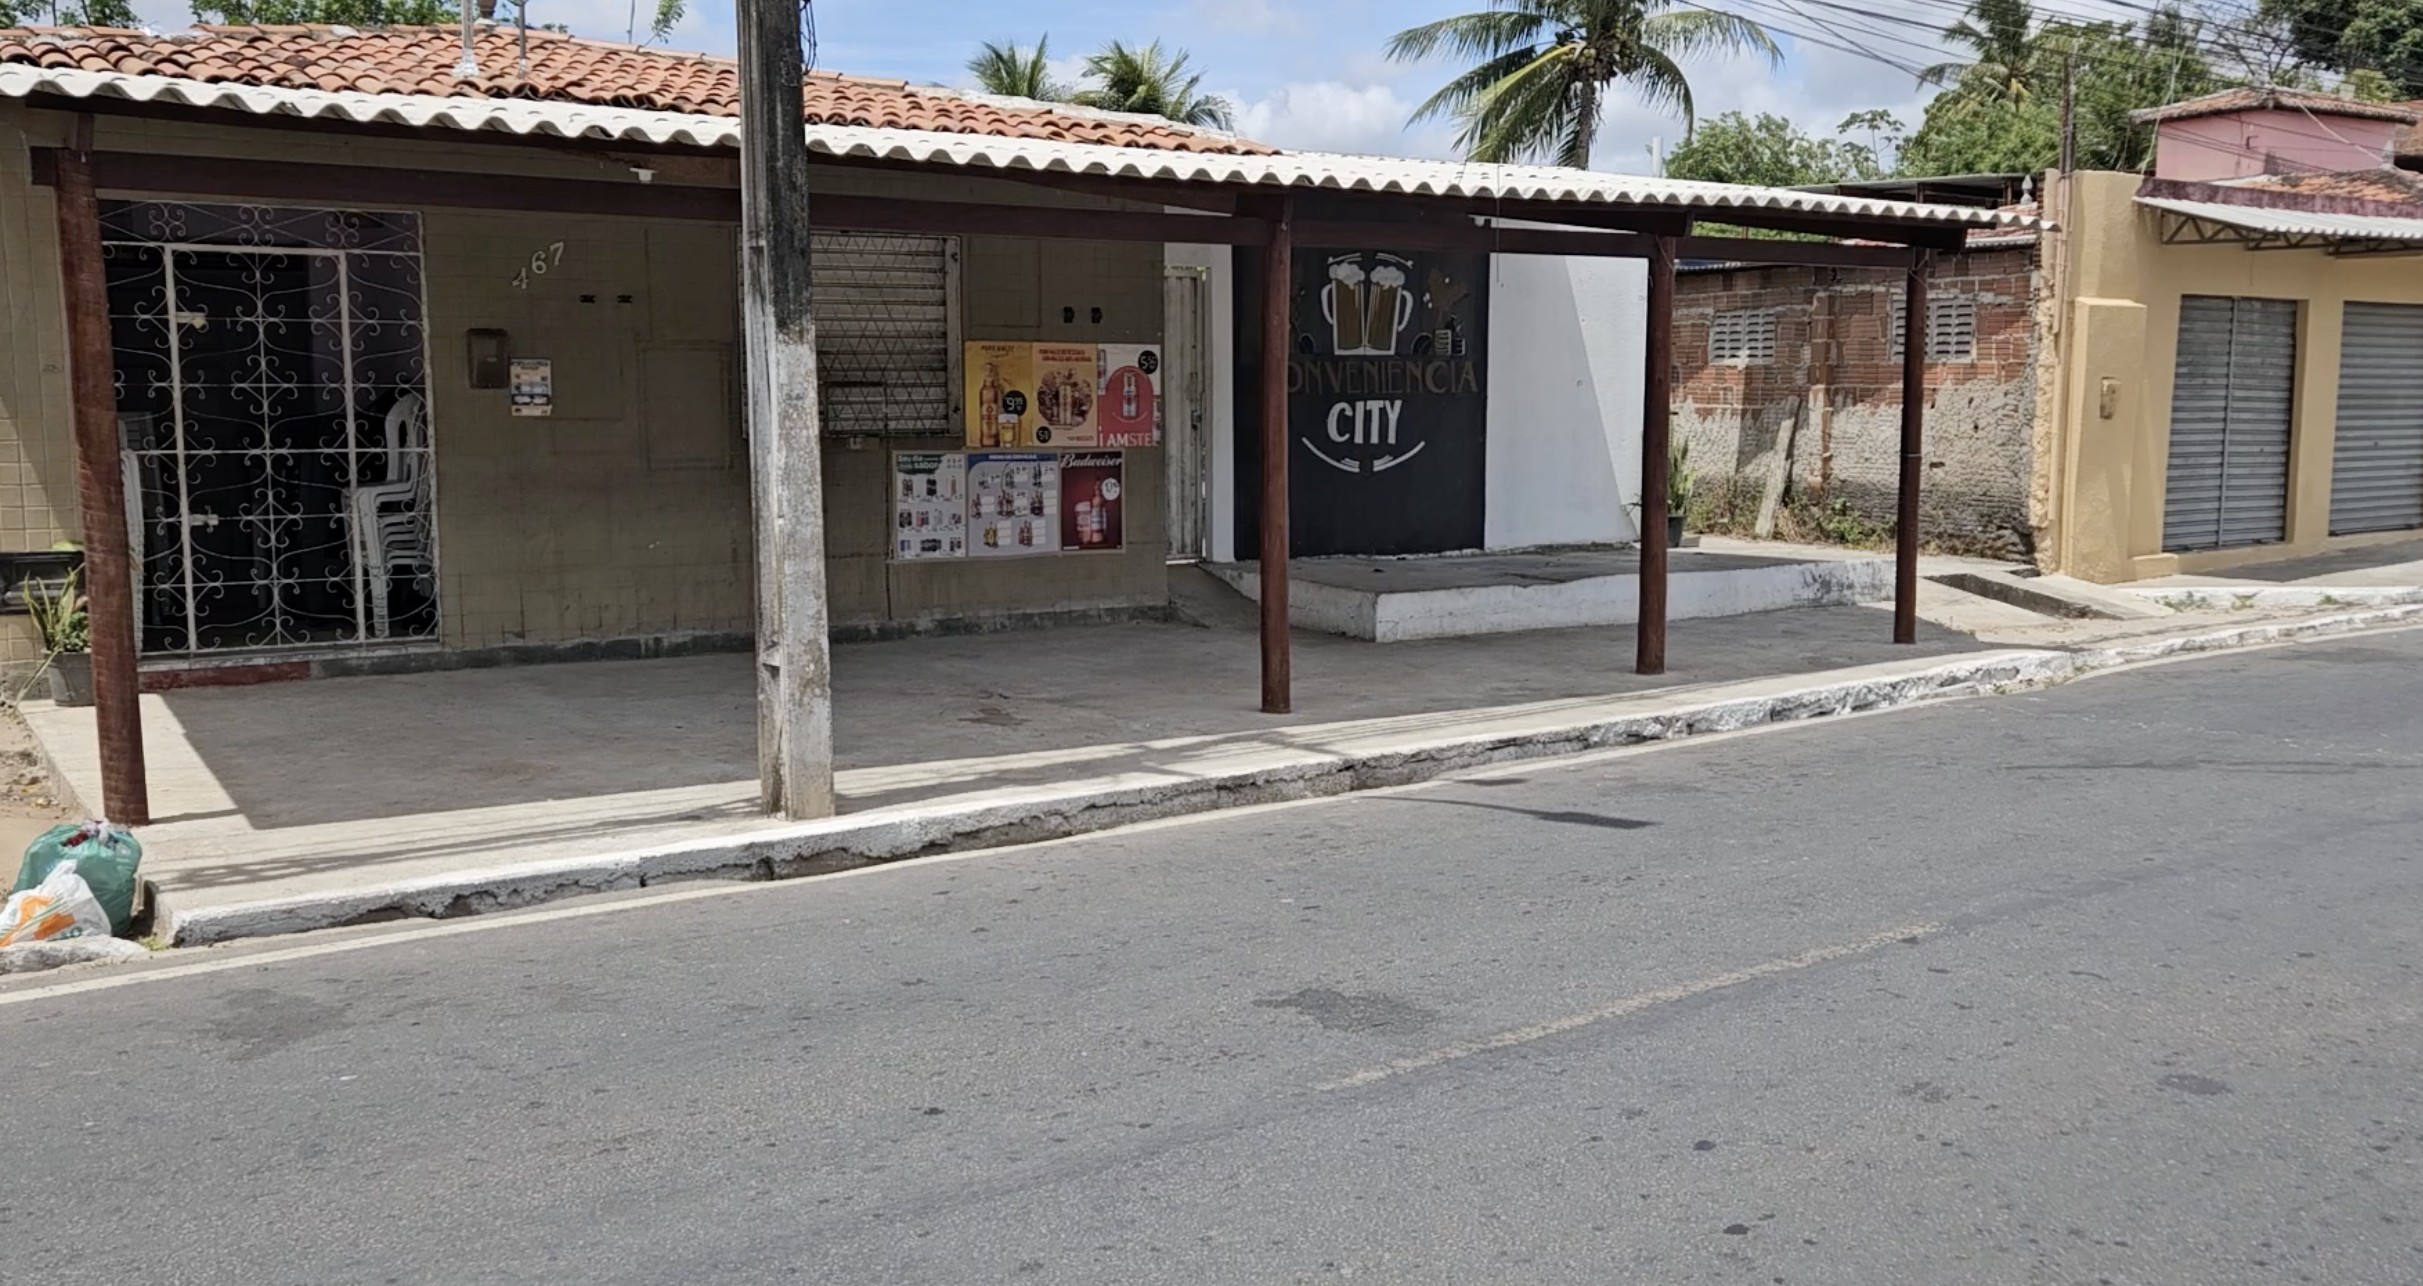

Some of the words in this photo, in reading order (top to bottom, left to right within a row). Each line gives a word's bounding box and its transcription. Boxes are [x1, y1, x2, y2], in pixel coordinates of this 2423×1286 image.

[511, 241, 564, 289] 467
[1288, 360, 1478, 393] ONVENIENCIA
[1327, 400, 1403, 444] CITY
[1060, 454, 1122, 469] Budweiser
